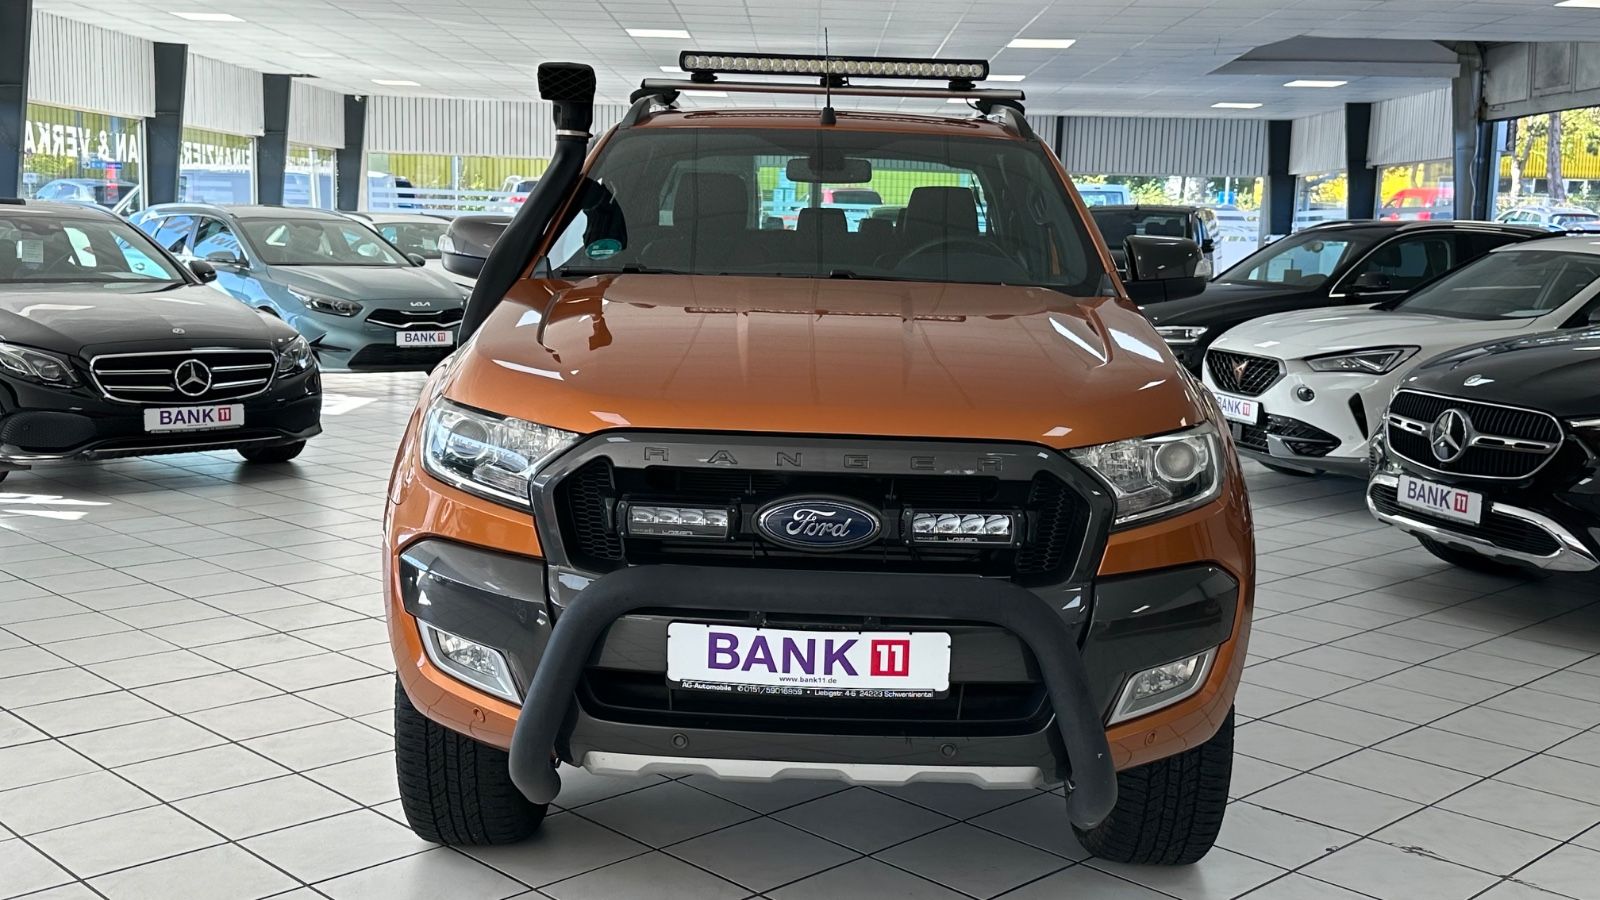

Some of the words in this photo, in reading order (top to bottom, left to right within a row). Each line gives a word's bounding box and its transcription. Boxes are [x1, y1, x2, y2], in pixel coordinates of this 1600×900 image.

[404, 332, 436, 343] BANK
[159, 408, 215, 425] BANK
[218, 407, 231, 421] 11
[643, 446, 1003, 473] RANGER
[1407, 480, 1452, 509] BANK
[1454, 493, 1468, 513] 11
[786, 508, 852, 537] Ford
[707, 631, 859, 676] BANK
[873, 641, 907, 675] 11
[779, 675, 837, 684] www.bank11.de
